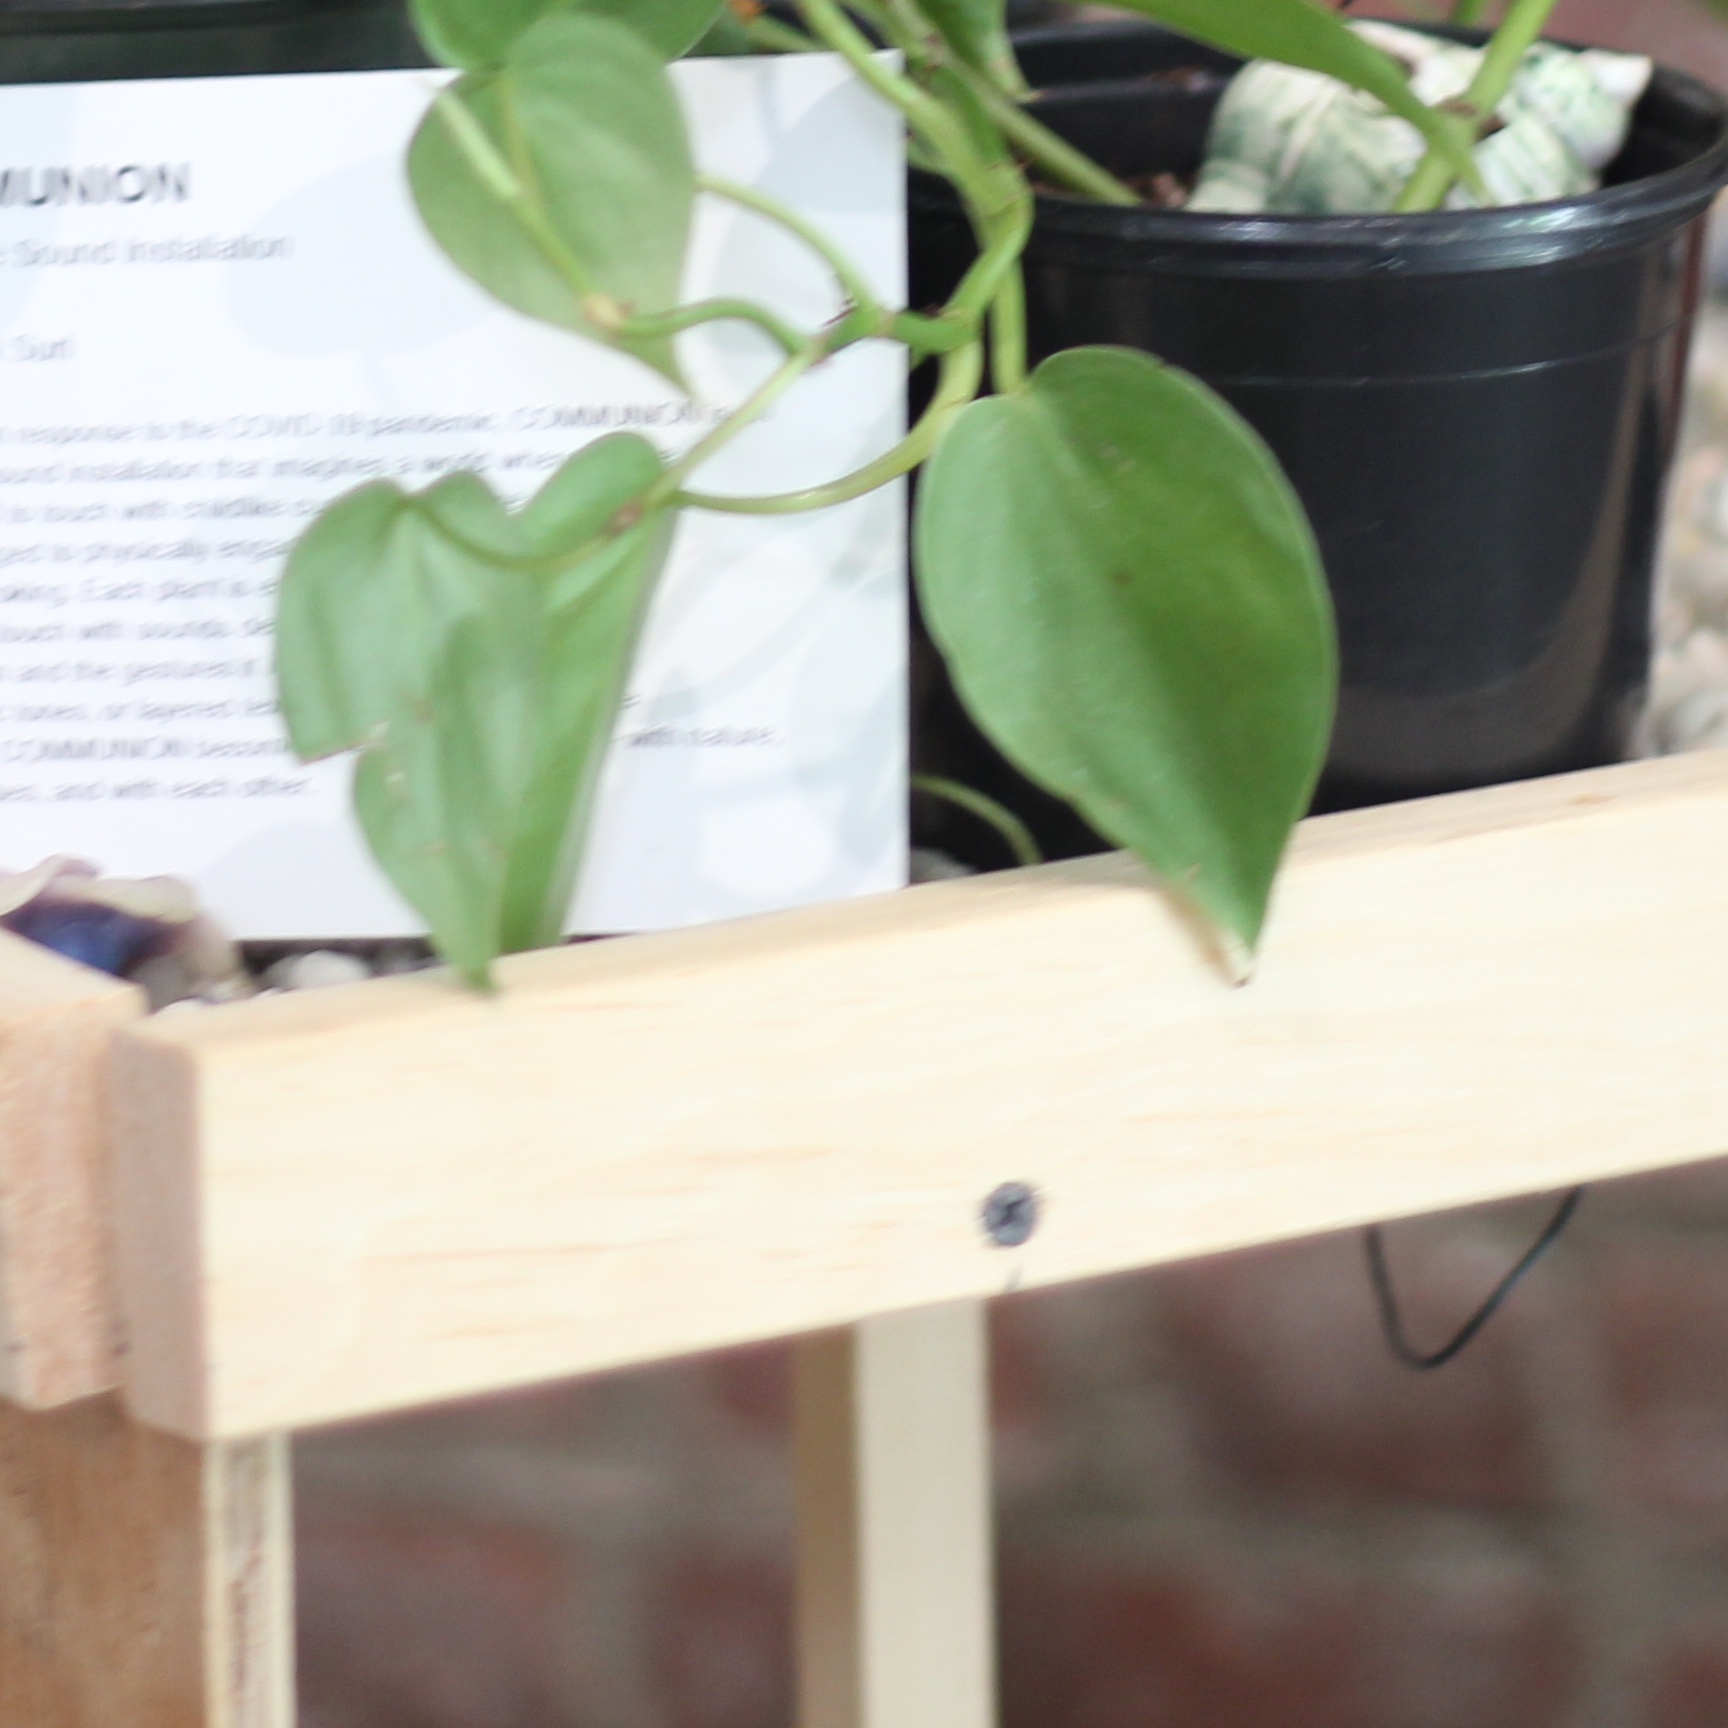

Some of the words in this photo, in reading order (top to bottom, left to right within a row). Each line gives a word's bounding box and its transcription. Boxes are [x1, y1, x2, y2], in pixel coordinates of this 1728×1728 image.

[15, 238, 112, 267] Sound
[121, 234, 291, 263] Installation
[15, 426, 134, 448] response
[177, 419, 215, 440] the
[69, 459, 204, 482] installation
